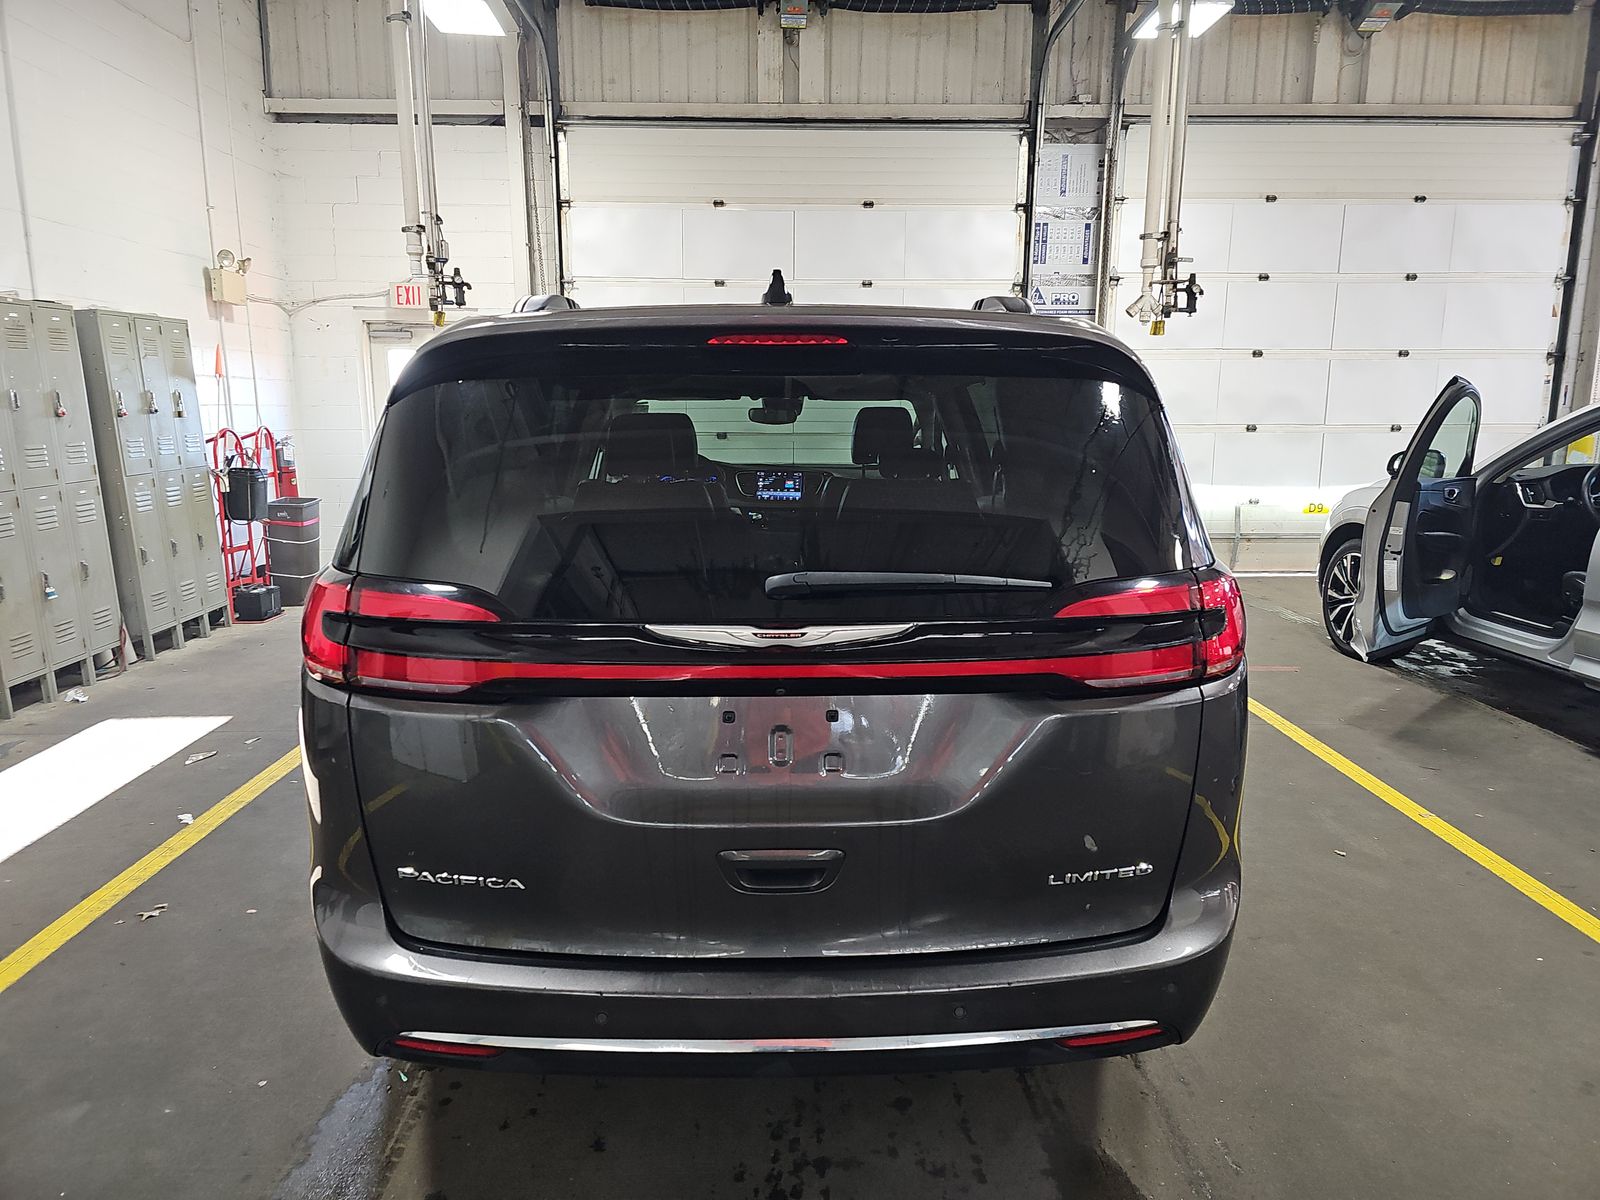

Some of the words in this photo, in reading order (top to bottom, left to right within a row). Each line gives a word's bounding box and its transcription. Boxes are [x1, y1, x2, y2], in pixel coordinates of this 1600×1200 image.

[396, 285, 422, 306] EXIT
[1052, 293, 1079, 302] PRO
[1308, 503, 1324, 513] D9
[397, 867, 526, 889] PACIFICA
[1048, 862, 1154, 885] LIMITED
